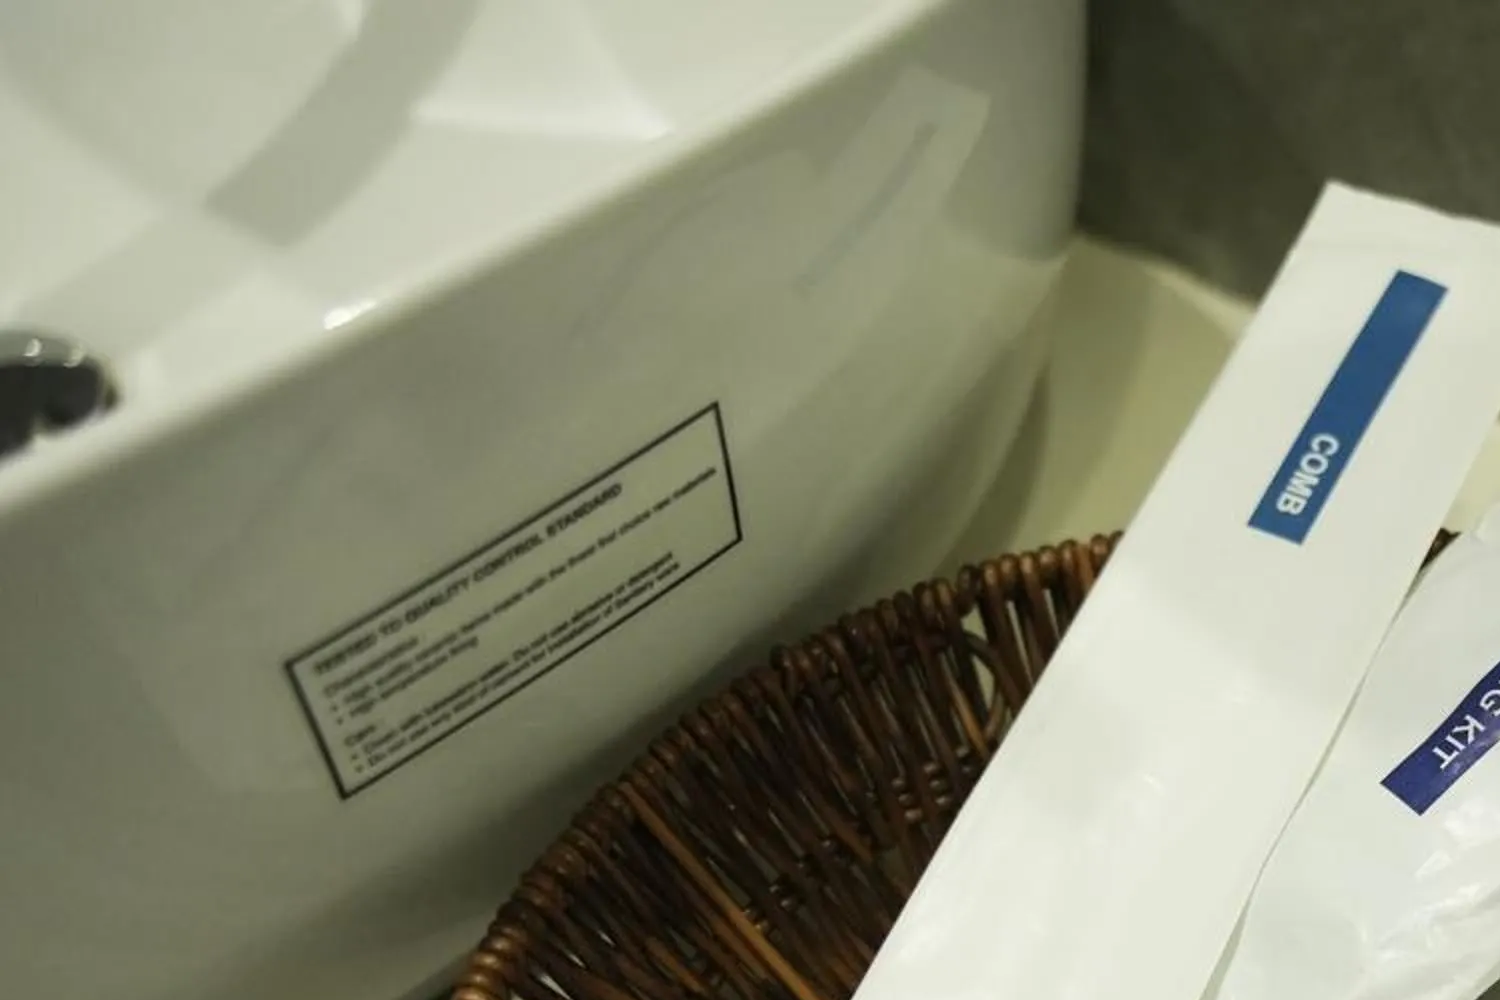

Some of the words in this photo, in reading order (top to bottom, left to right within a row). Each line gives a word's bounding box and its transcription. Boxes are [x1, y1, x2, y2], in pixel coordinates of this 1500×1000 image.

[1275, 433, 1339, 515] COMB
[404, 575, 471, 625] QUALITY
[472, 531, 543, 584] CONTROL
[545, 482, 622, 539] STANDARD
[1432, 715, 1486, 769] KIT
